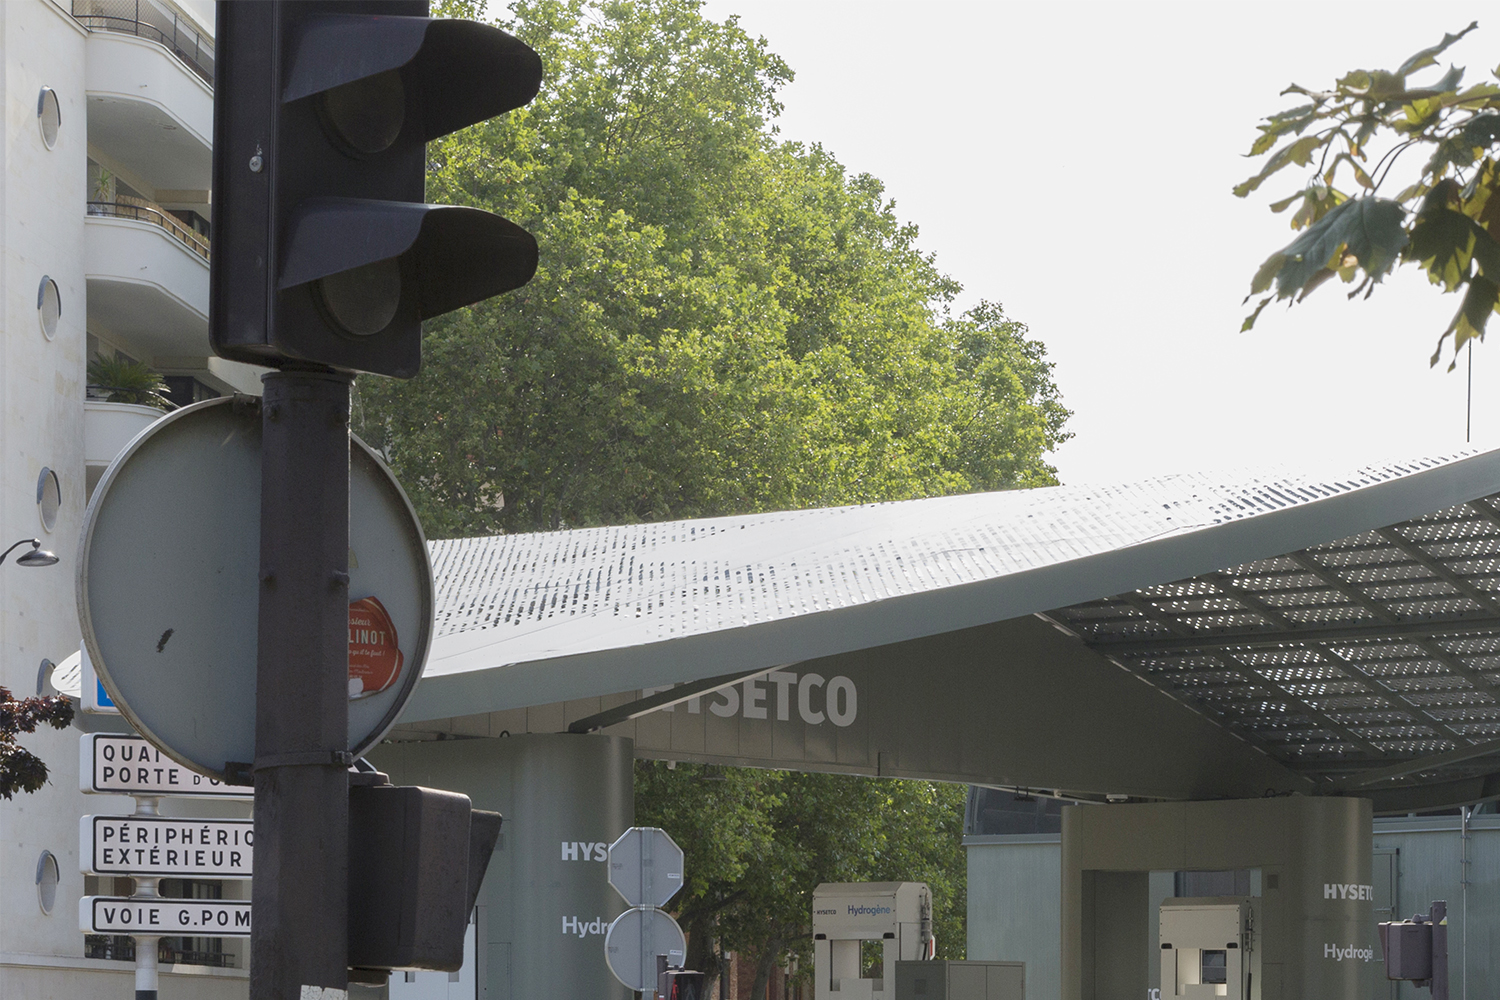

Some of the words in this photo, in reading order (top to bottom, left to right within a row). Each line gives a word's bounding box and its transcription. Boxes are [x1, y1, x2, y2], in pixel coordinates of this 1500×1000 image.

[348, 617, 371, 627] sieur
[103, 766, 179, 785] PORTE
[103, 845, 242, 867] EXTÉRIEUR
[561, 841, 612, 862] HYS
[103, 907, 160, 925] VOIE
[847, 904, 891, 917] Hydrogène
